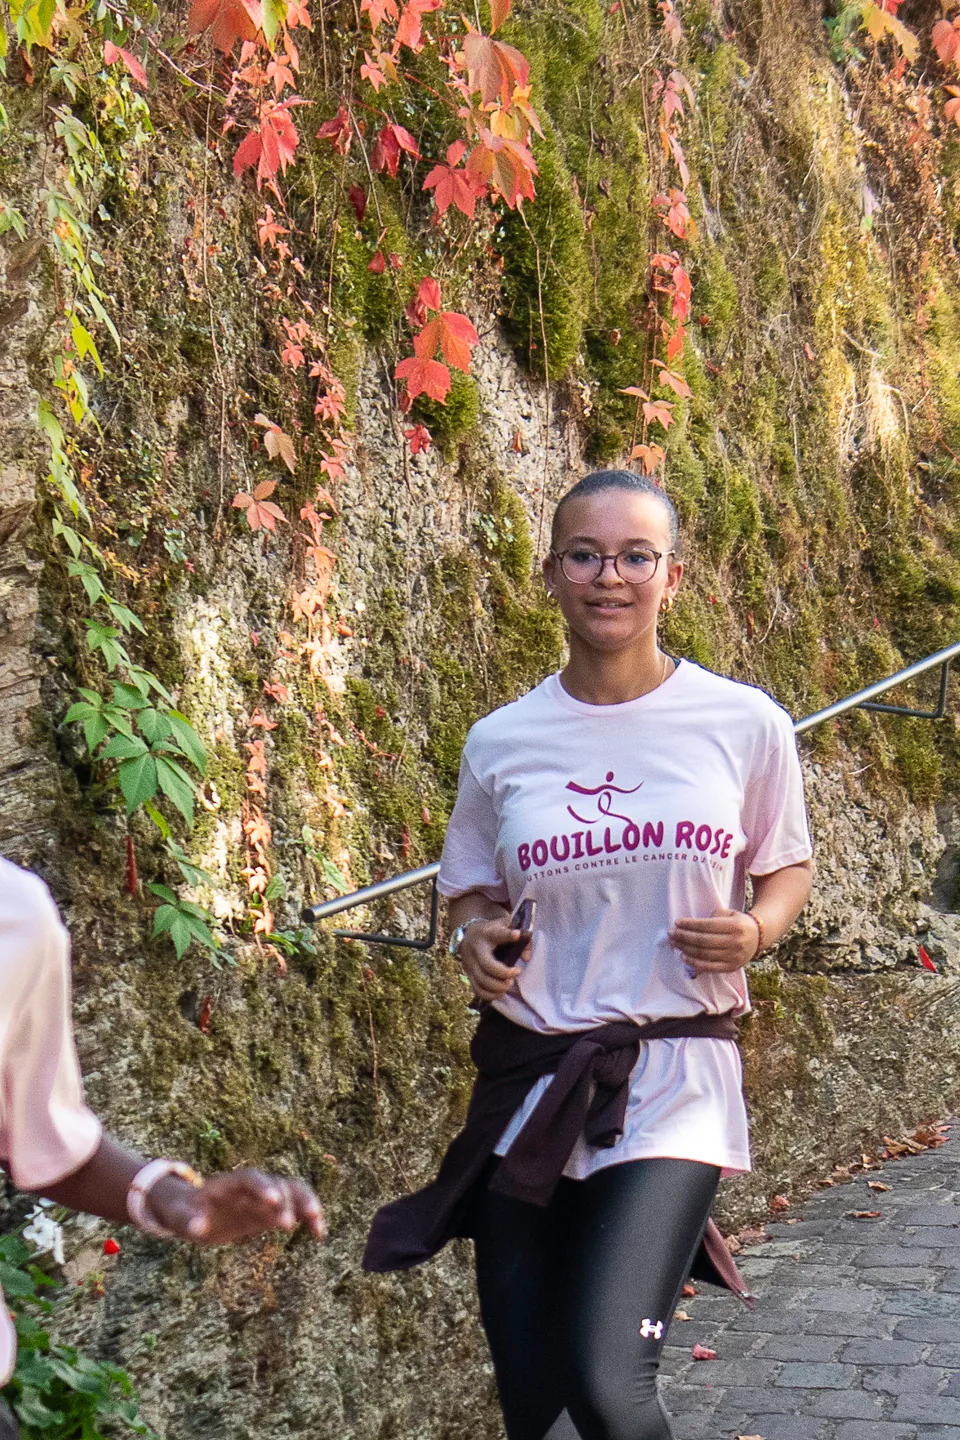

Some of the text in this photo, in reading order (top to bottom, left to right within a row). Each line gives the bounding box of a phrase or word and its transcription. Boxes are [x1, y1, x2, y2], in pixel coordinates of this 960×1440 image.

[517, 821, 734, 872] BOUILLON ROSE
[525, 866, 570, 882] UTTONS
[574, 857, 620, 872] CONTRE
[624, 854, 638, 864] LE
[642, 852, 688, 863] CANCER
